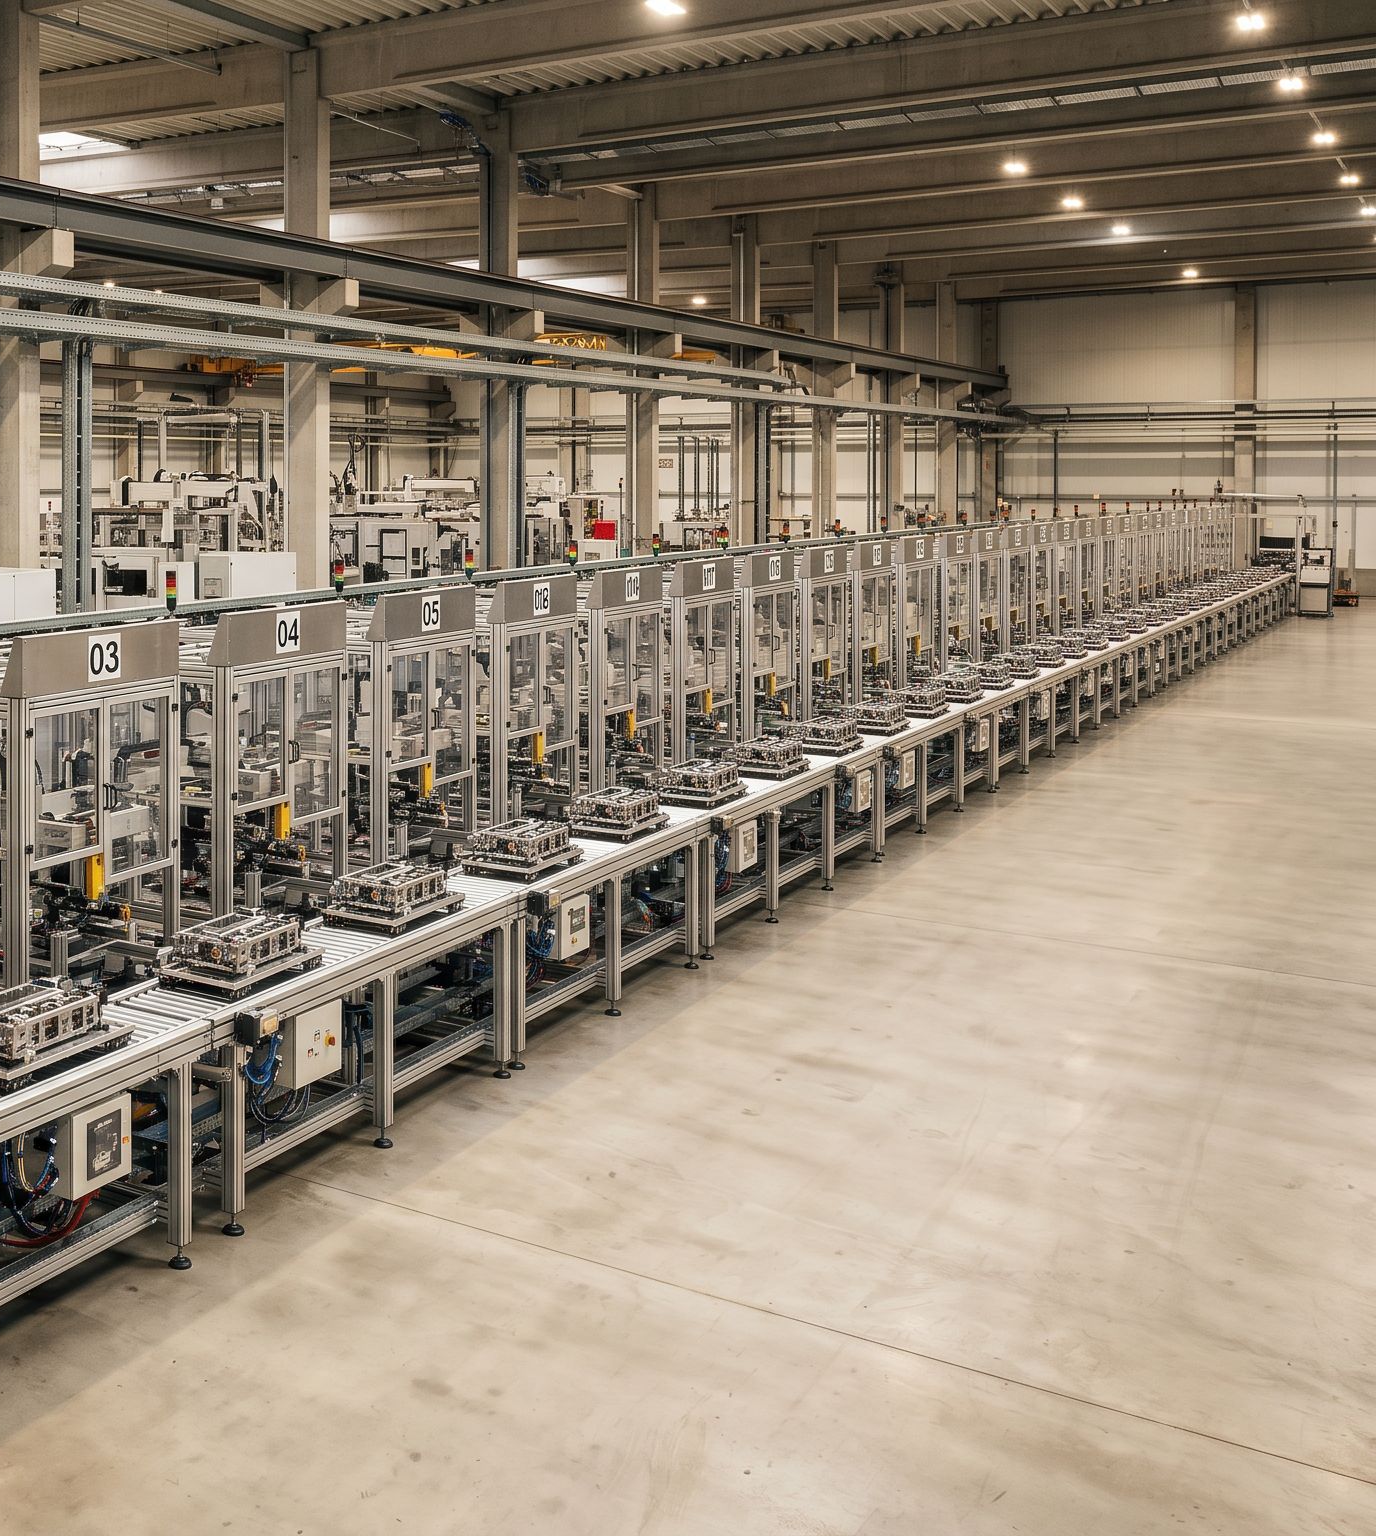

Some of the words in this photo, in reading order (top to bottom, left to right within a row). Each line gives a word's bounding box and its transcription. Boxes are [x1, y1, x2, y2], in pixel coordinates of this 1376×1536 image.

[423, 600, 439, 626] 05
[278, 618, 299, 648] 04
[90, 641, 119, 675] 03
